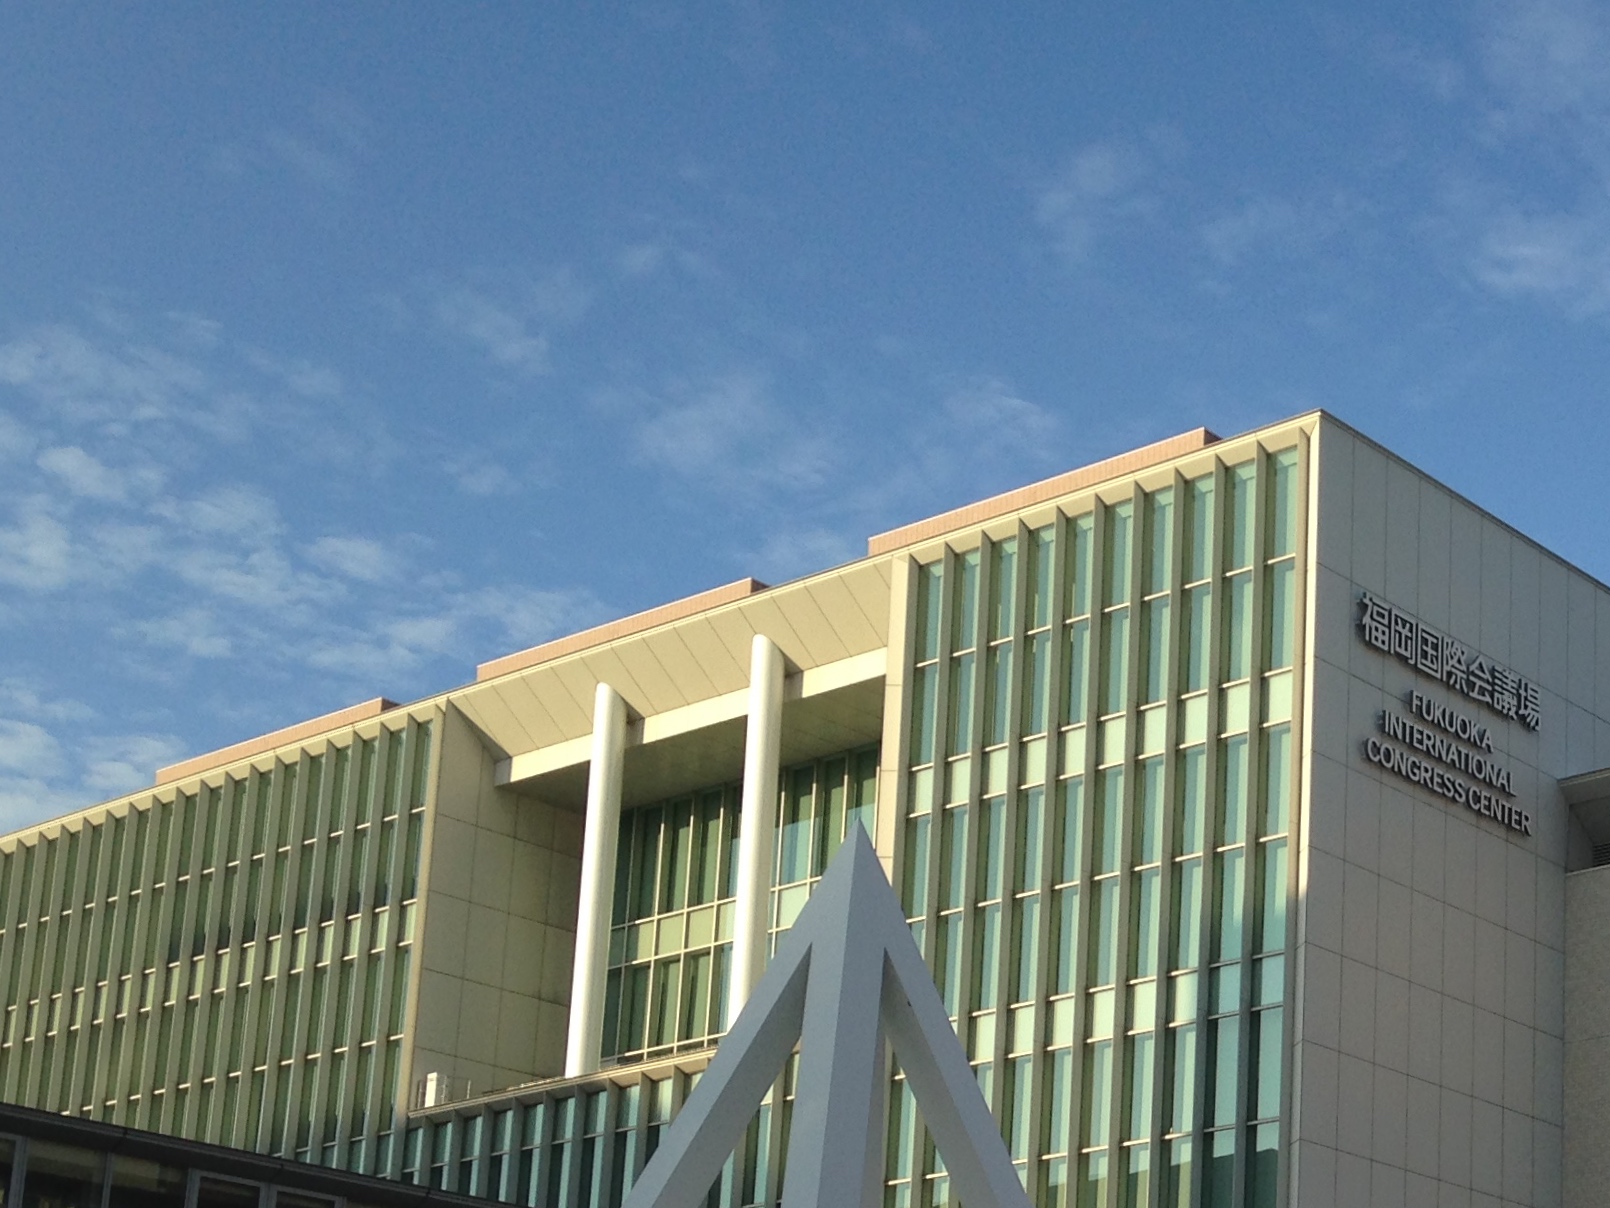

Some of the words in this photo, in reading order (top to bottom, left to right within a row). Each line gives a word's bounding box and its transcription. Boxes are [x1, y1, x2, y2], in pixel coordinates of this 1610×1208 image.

[1360, 592, 1541, 731] 福岡国際会議場
[1382, 710, 1516, 796] INTERNATIONAL
[1410, 690, 1493, 753] FUKUOKA
[1367, 737, 1466, 803] CONGRESS
[1469, 786, 1532, 836] CENTER
